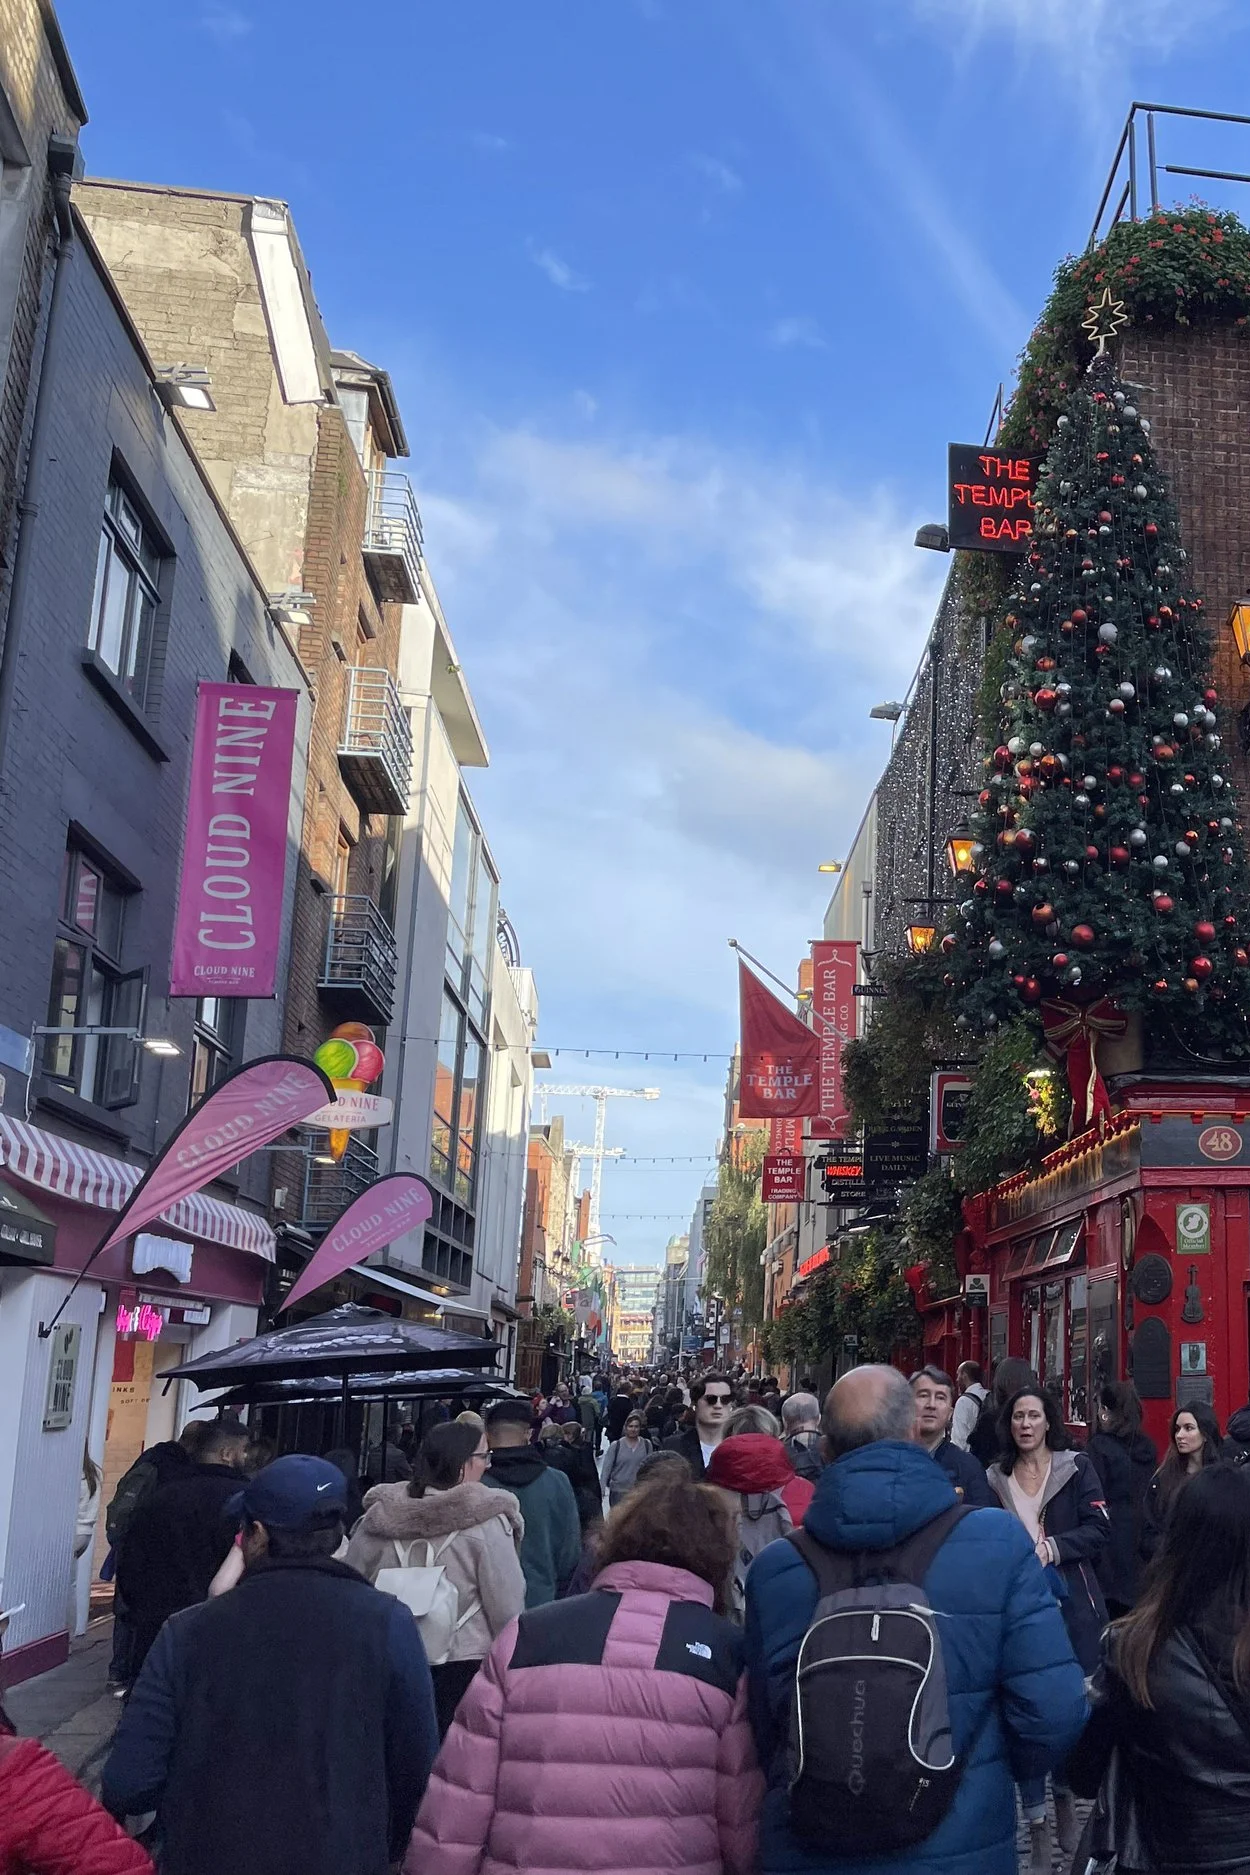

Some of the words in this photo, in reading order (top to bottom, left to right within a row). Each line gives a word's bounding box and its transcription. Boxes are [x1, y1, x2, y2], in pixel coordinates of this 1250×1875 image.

[978, 455, 1030, 481] THE
[953, 483, 1036, 508] TEMPL
[211, 697, 277, 796] NINE
[198, 813, 256, 951] CLOUD
[194, 965, 228, 977] CLOUD
[230, 966, 256, 978] NINE
[823, 968, 837, 1002] BAR
[822, 1005, 836, 1074] TEMPLE
[746, 1073, 813, 1088] TEMPLE
[765, 1064, 793, 1075] THE
[351, 1096, 380, 1110] NINE
[763, 1087, 797, 1099] BAR
[821, 1076, 836, 1112] THE
[176, 1113, 255, 1169] CLOUD
[254, 1070, 312, 1116] NINE
[314, 1113, 367, 1123] GELATERIA
[785, 1119, 796, 1153] MPLE
[1206, 1132, 1233, 1152] 48
[767, 1167, 801, 1175] TEMPLE
[776, 1159, 793, 1167] THE
[774, 1176, 793, 1184] BAR
[331, 1213, 383, 1252] CLOUD
[383, 1186, 424, 1217] NINE
[848, 1680, 866, 1796] Quechua
